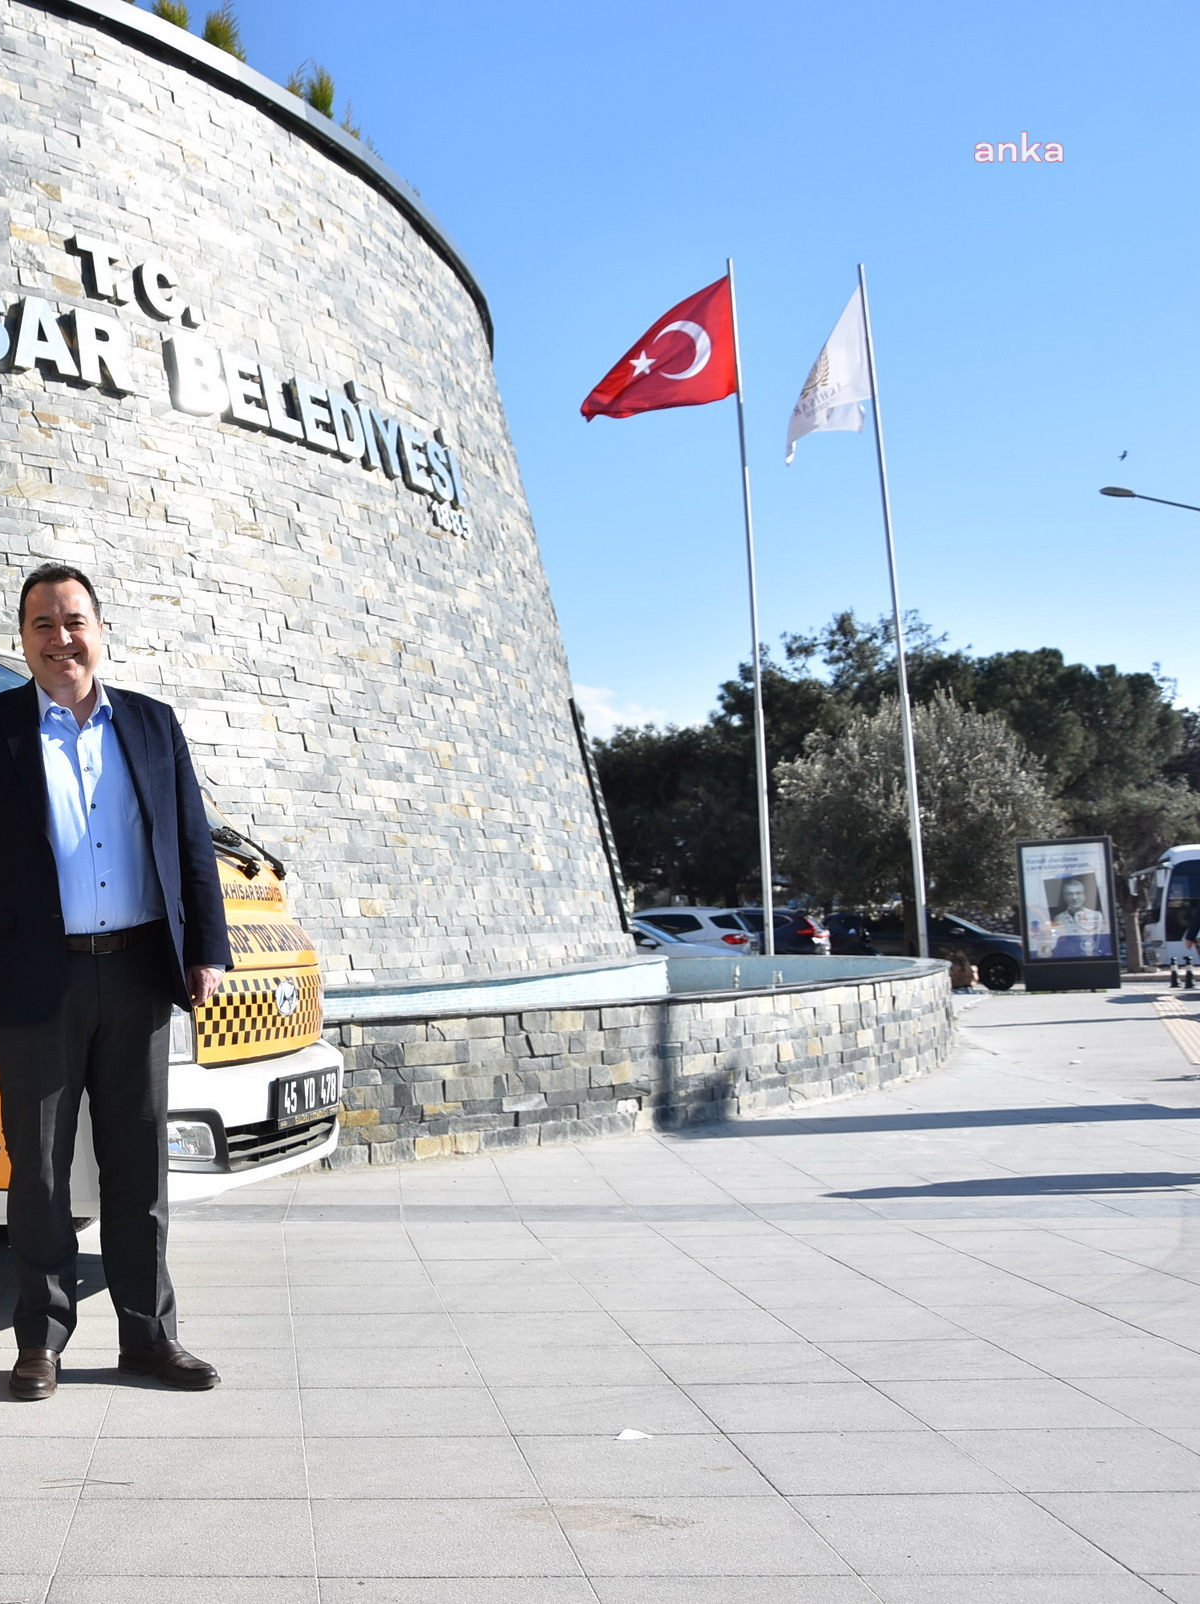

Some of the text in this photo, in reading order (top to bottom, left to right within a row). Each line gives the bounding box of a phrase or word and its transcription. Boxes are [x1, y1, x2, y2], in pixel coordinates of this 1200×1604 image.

[65, 234, 201, 328] T.C.
[164, 332, 466, 508] BELEDİYESİ
[429, 500, 472, 541] 1885
[221, 880, 256, 901] KHİSAR
[284, 1072, 337, 1114] 45 YD 478
